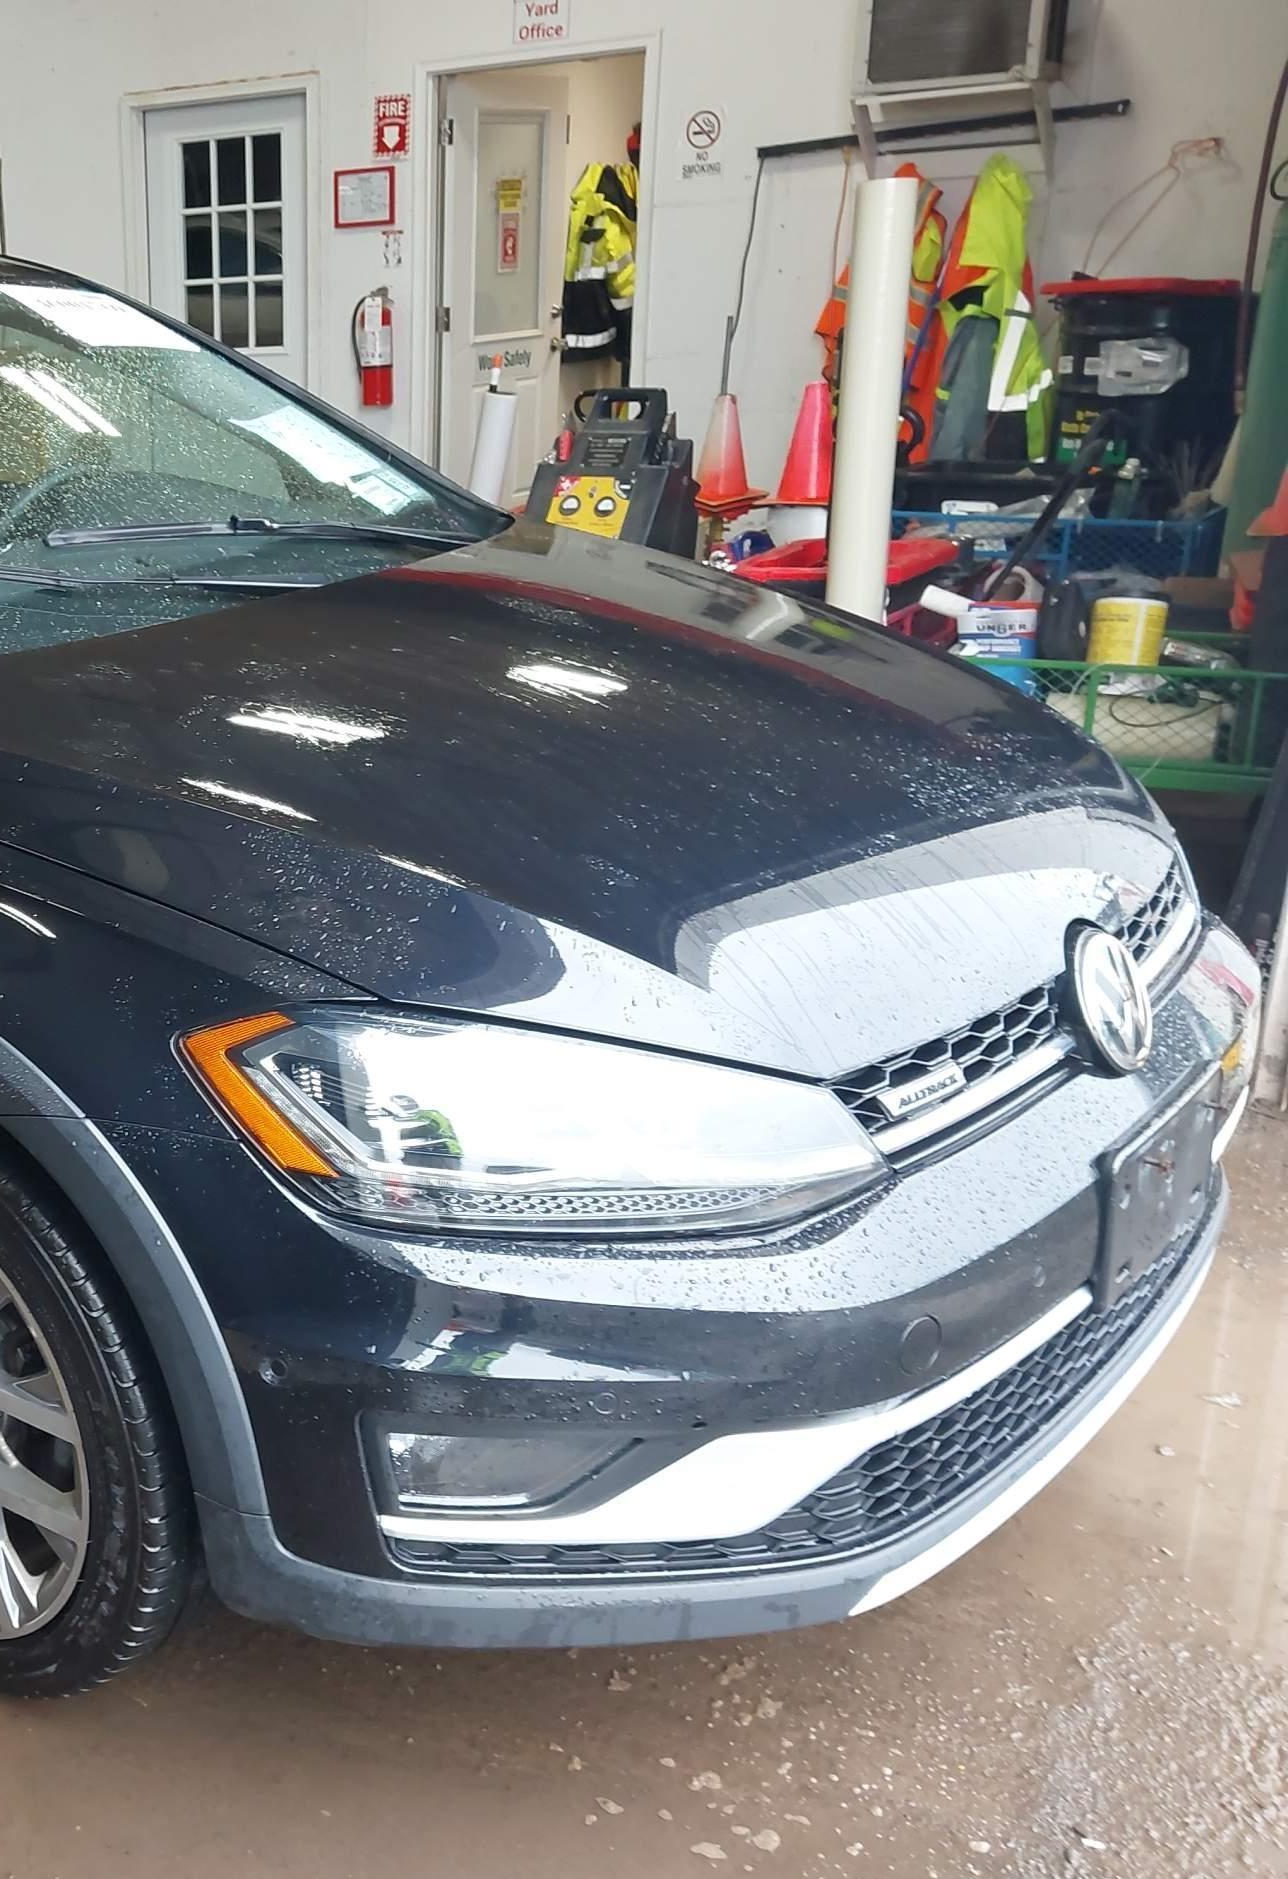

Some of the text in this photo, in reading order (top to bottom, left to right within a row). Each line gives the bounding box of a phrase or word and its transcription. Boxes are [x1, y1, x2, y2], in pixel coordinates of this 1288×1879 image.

[525, 0, 558, 17] Yard
[519, 23, 563, 40] Office
[379, 101, 406, 117] FIRE
[696, 151, 709, 161] NO
[682, 162, 721, 178] SMOKING
[504, 350, 532, 368] Safety
[976, 623, 1027, 635] UNGER
[898, 1073, 958, 1109] ALLTRACK
